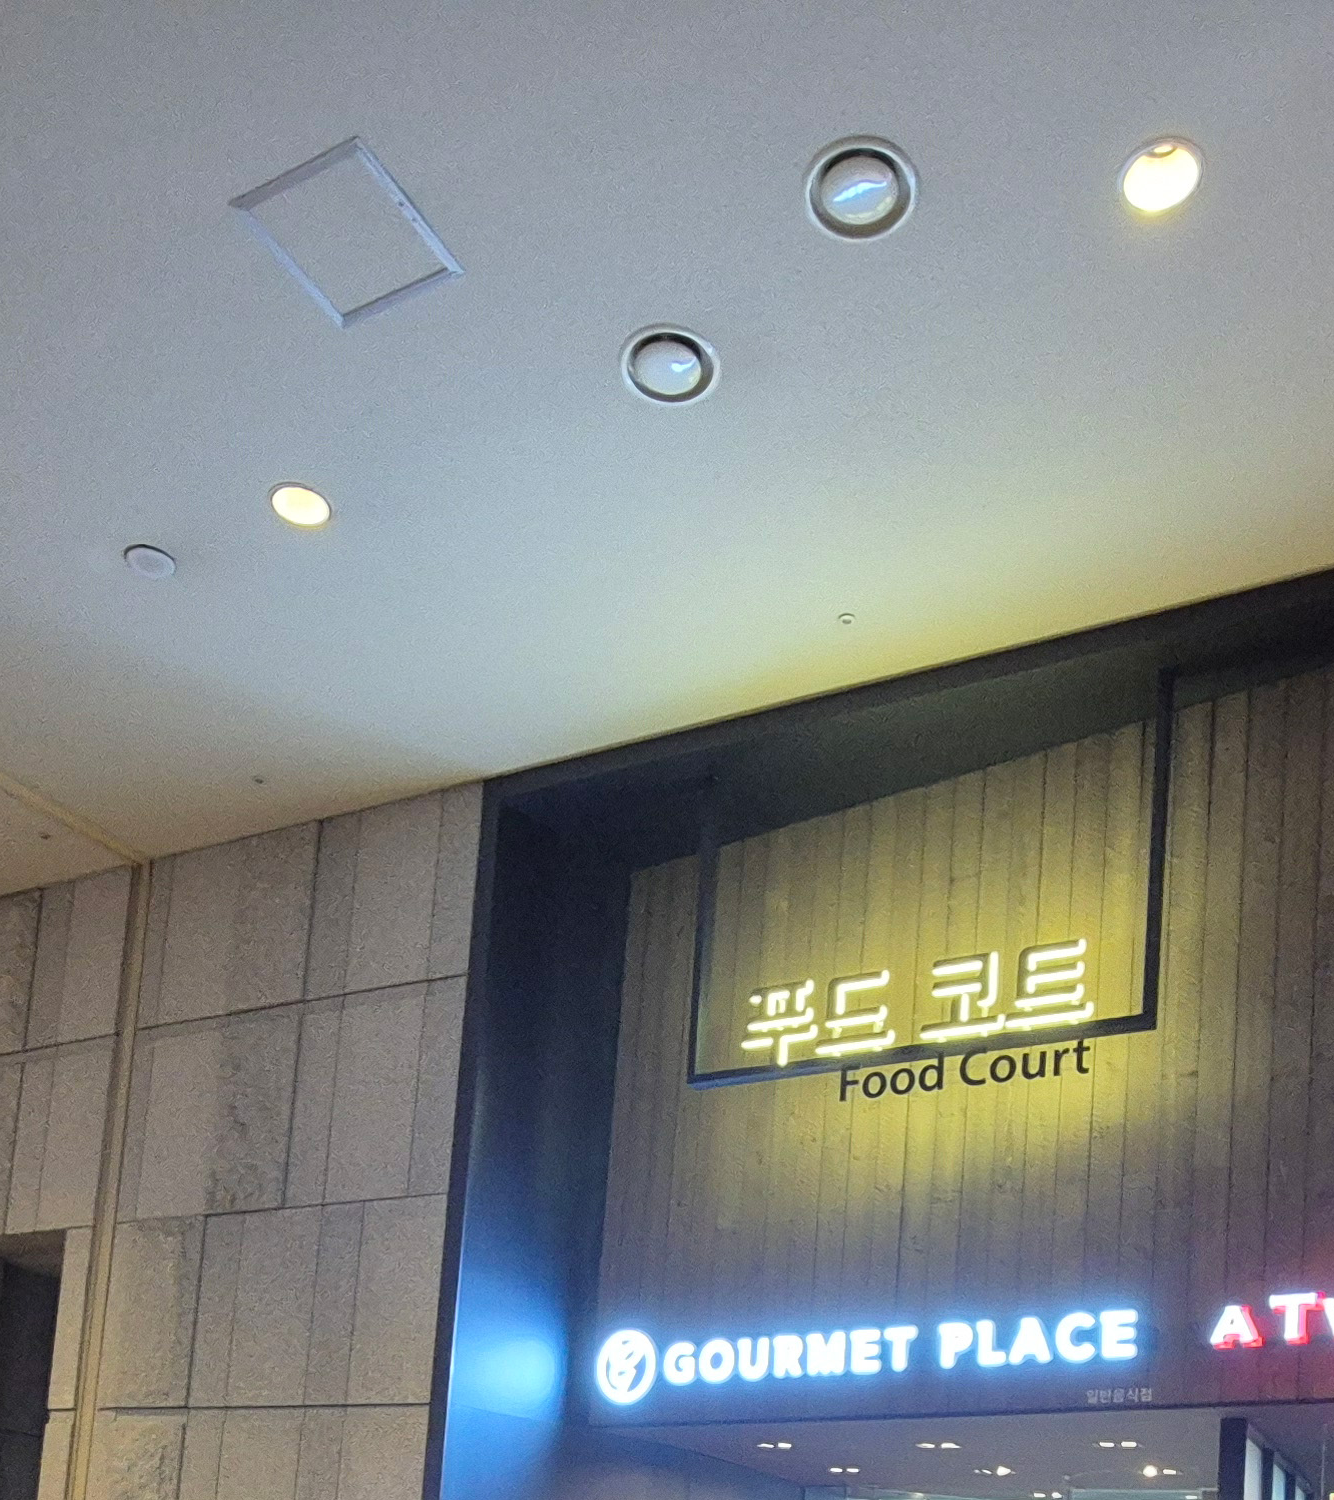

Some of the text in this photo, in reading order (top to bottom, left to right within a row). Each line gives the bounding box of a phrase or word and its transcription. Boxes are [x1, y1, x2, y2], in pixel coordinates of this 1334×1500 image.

[740, 937, 1095, 1067] 푸드 코트
[838, 1039, 1091, 1102] Food Court
[662, 1307, 1139, 1386] GOURMET PLACE
[1209, 1304, 1265, 1350] A
